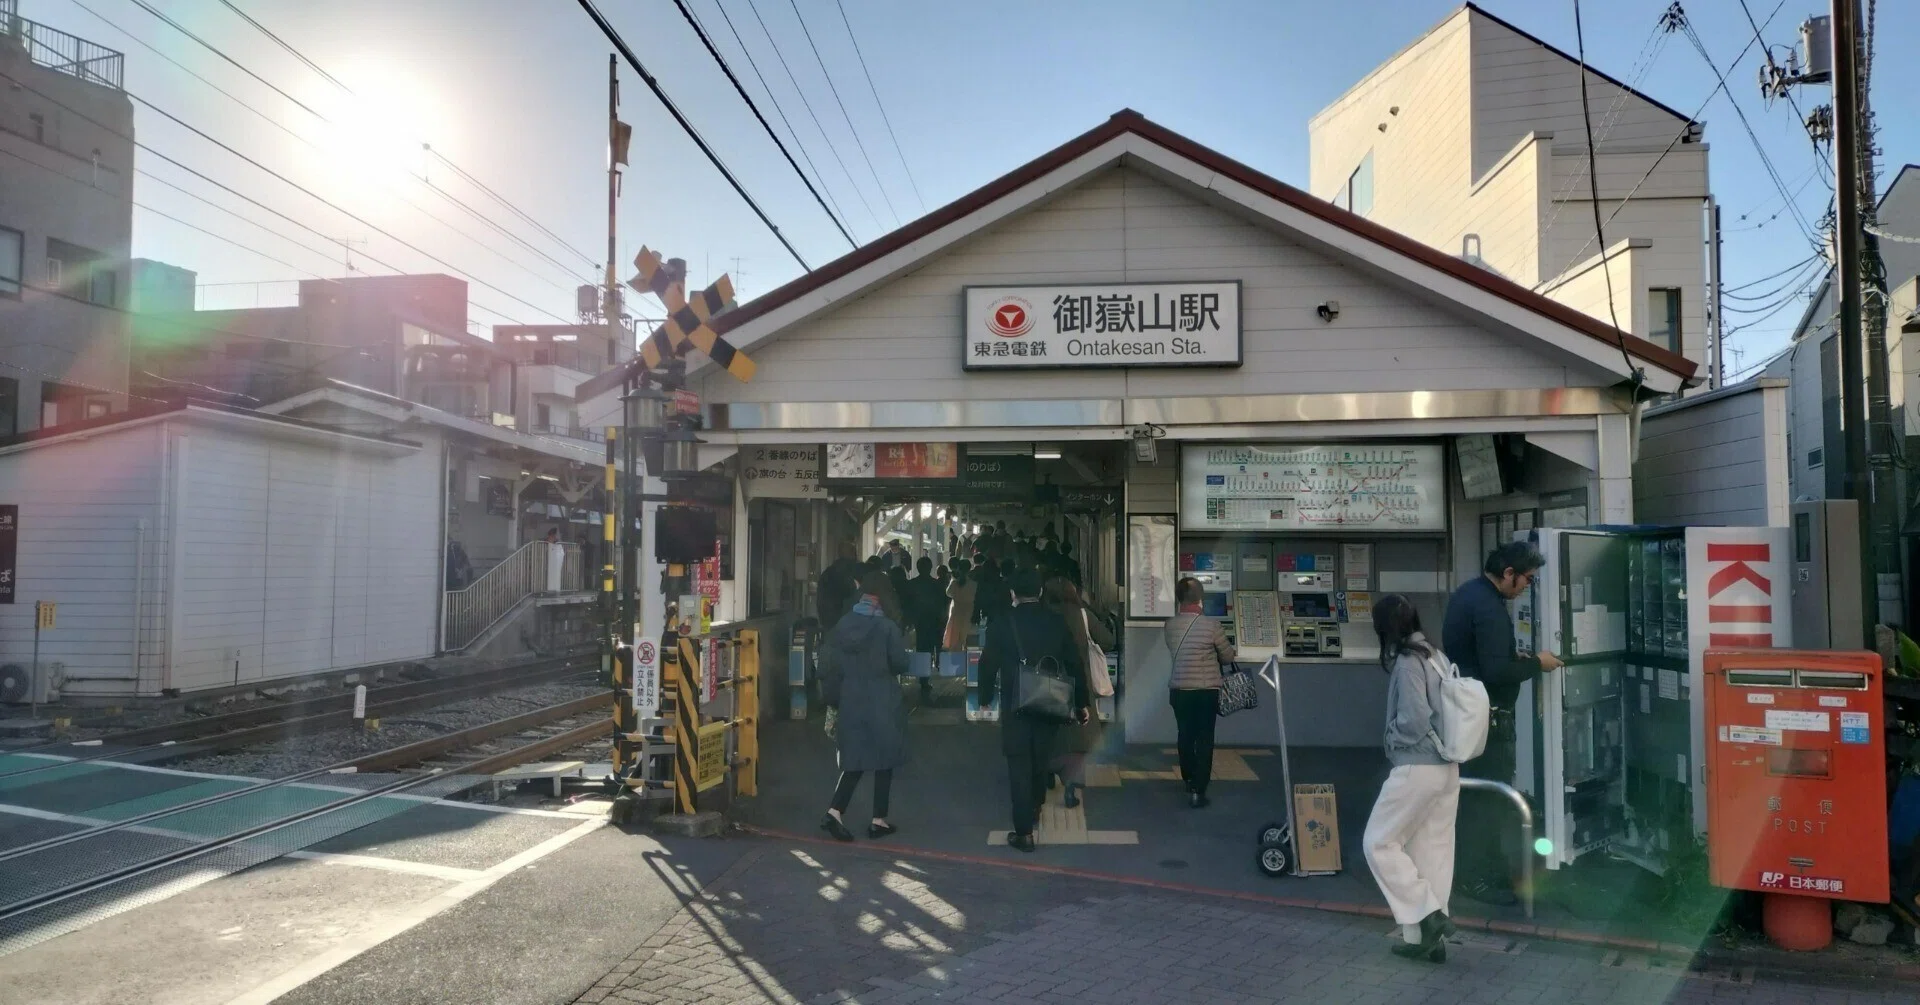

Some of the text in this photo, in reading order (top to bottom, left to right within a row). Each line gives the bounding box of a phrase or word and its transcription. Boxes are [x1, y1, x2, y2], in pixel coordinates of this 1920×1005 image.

[1053, 293, 1220, 334] 御嶽山駅
[974, 341, 1048, 357] 東急電鉄
[1067, 337, 1207, 357] Ontakesan Sta.
[637, 669, 645, 707] 立入禁止
[646, 669, 655, 707] 係員以外
[1774, 818, 1827, 834] POST
[1789, 876, 1844, 893] 日本郵便
